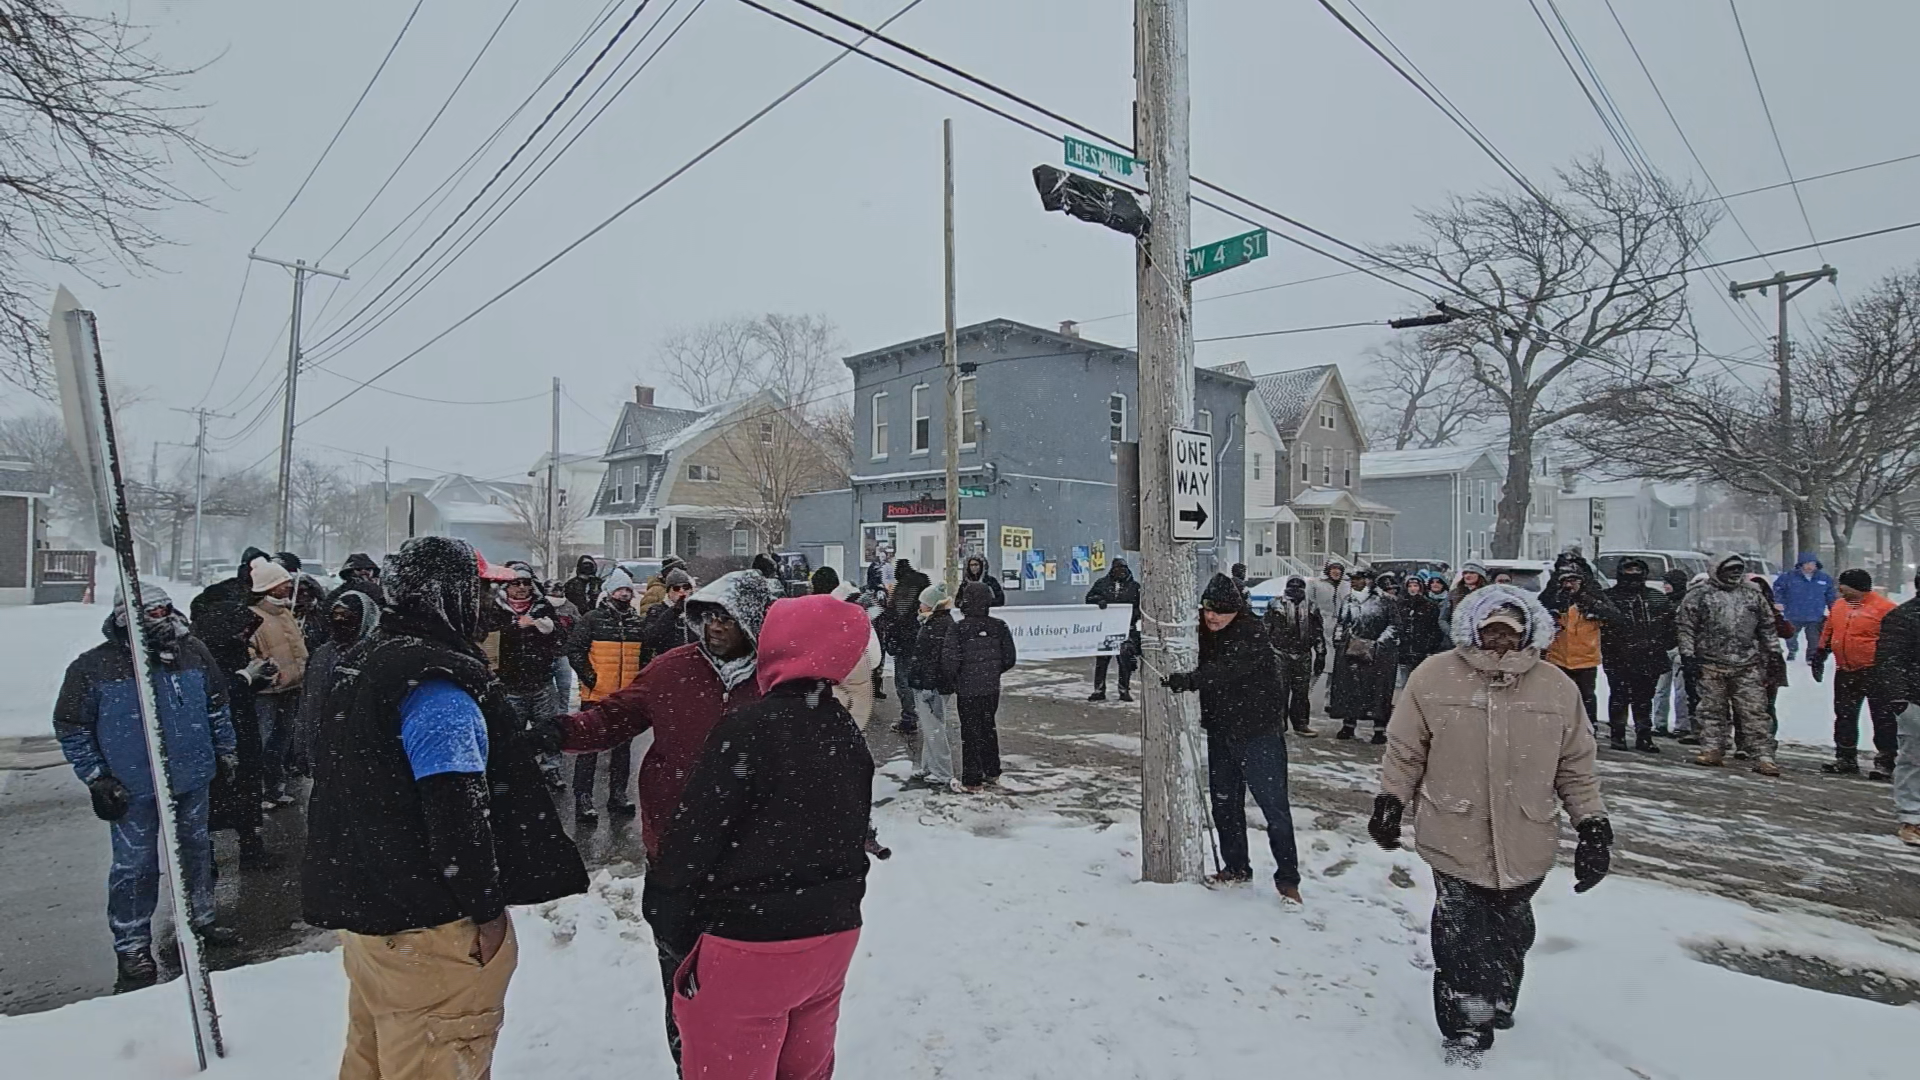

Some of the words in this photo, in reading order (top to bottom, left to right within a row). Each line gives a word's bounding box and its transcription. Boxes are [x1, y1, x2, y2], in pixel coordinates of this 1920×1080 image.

[1067, 140, 1124, 174] CHESTNUT
[1192, 249, 1206, 273] W
[1213, 244, 1226, 265] 4
[1242, 233, 1263, 258] ST
[1176, 440, 1208, 466] ONE
[1176, 469, 1209, 496] WAY
[1003, 534, 1032, 549] EBT
[1026, 624, 1069, 639] Advisory
[1072, 621, 1103, 635] Board
